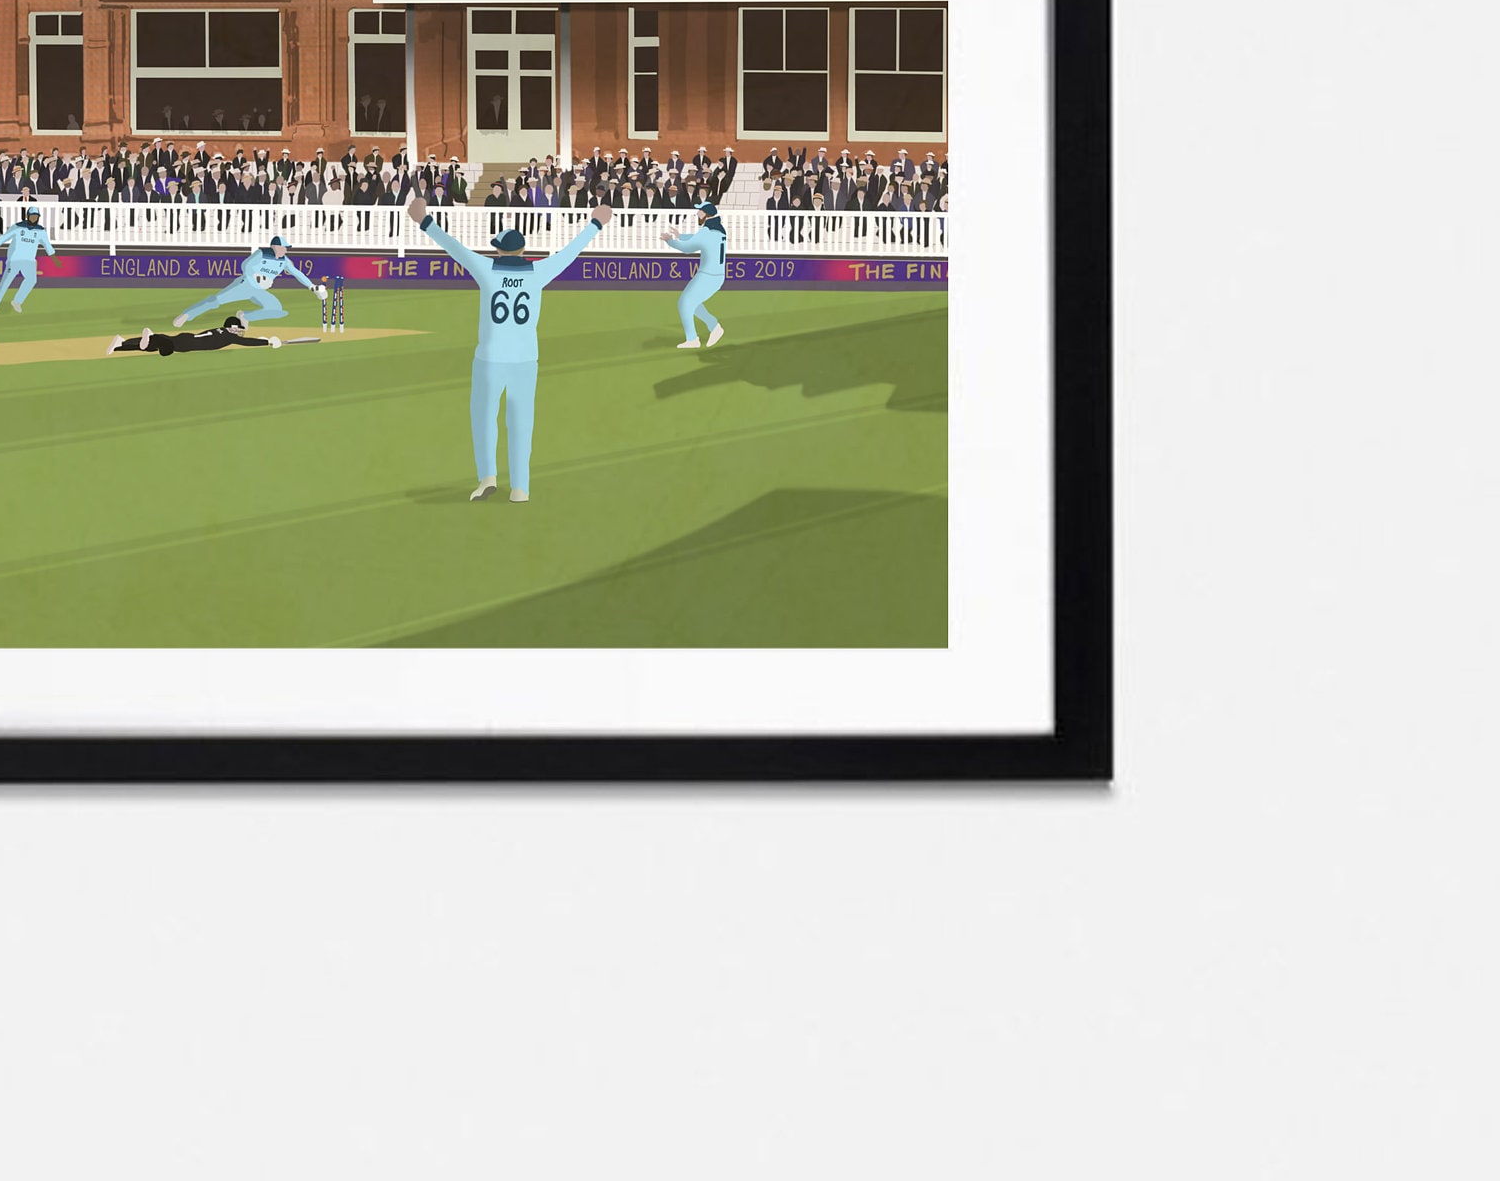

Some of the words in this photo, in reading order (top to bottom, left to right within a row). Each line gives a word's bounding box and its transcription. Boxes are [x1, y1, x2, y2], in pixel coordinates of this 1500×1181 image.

[101, 258, 181, 277] ENGLAND
[187, 259, 200, 276] &
[207, 259, 242, 276] WAL
[372, 260, 418, 277] THE
[582, 261, 662, 280] ENGLAND
[669, 262, 682, 279] &
[689, 261, 746, 279] WES
[755, 261, 795, 279] 2019
[848, 263, 895, 281] THE
[501, 277, 524, 288] ROOT
[490, 290, 531, 325] 66
